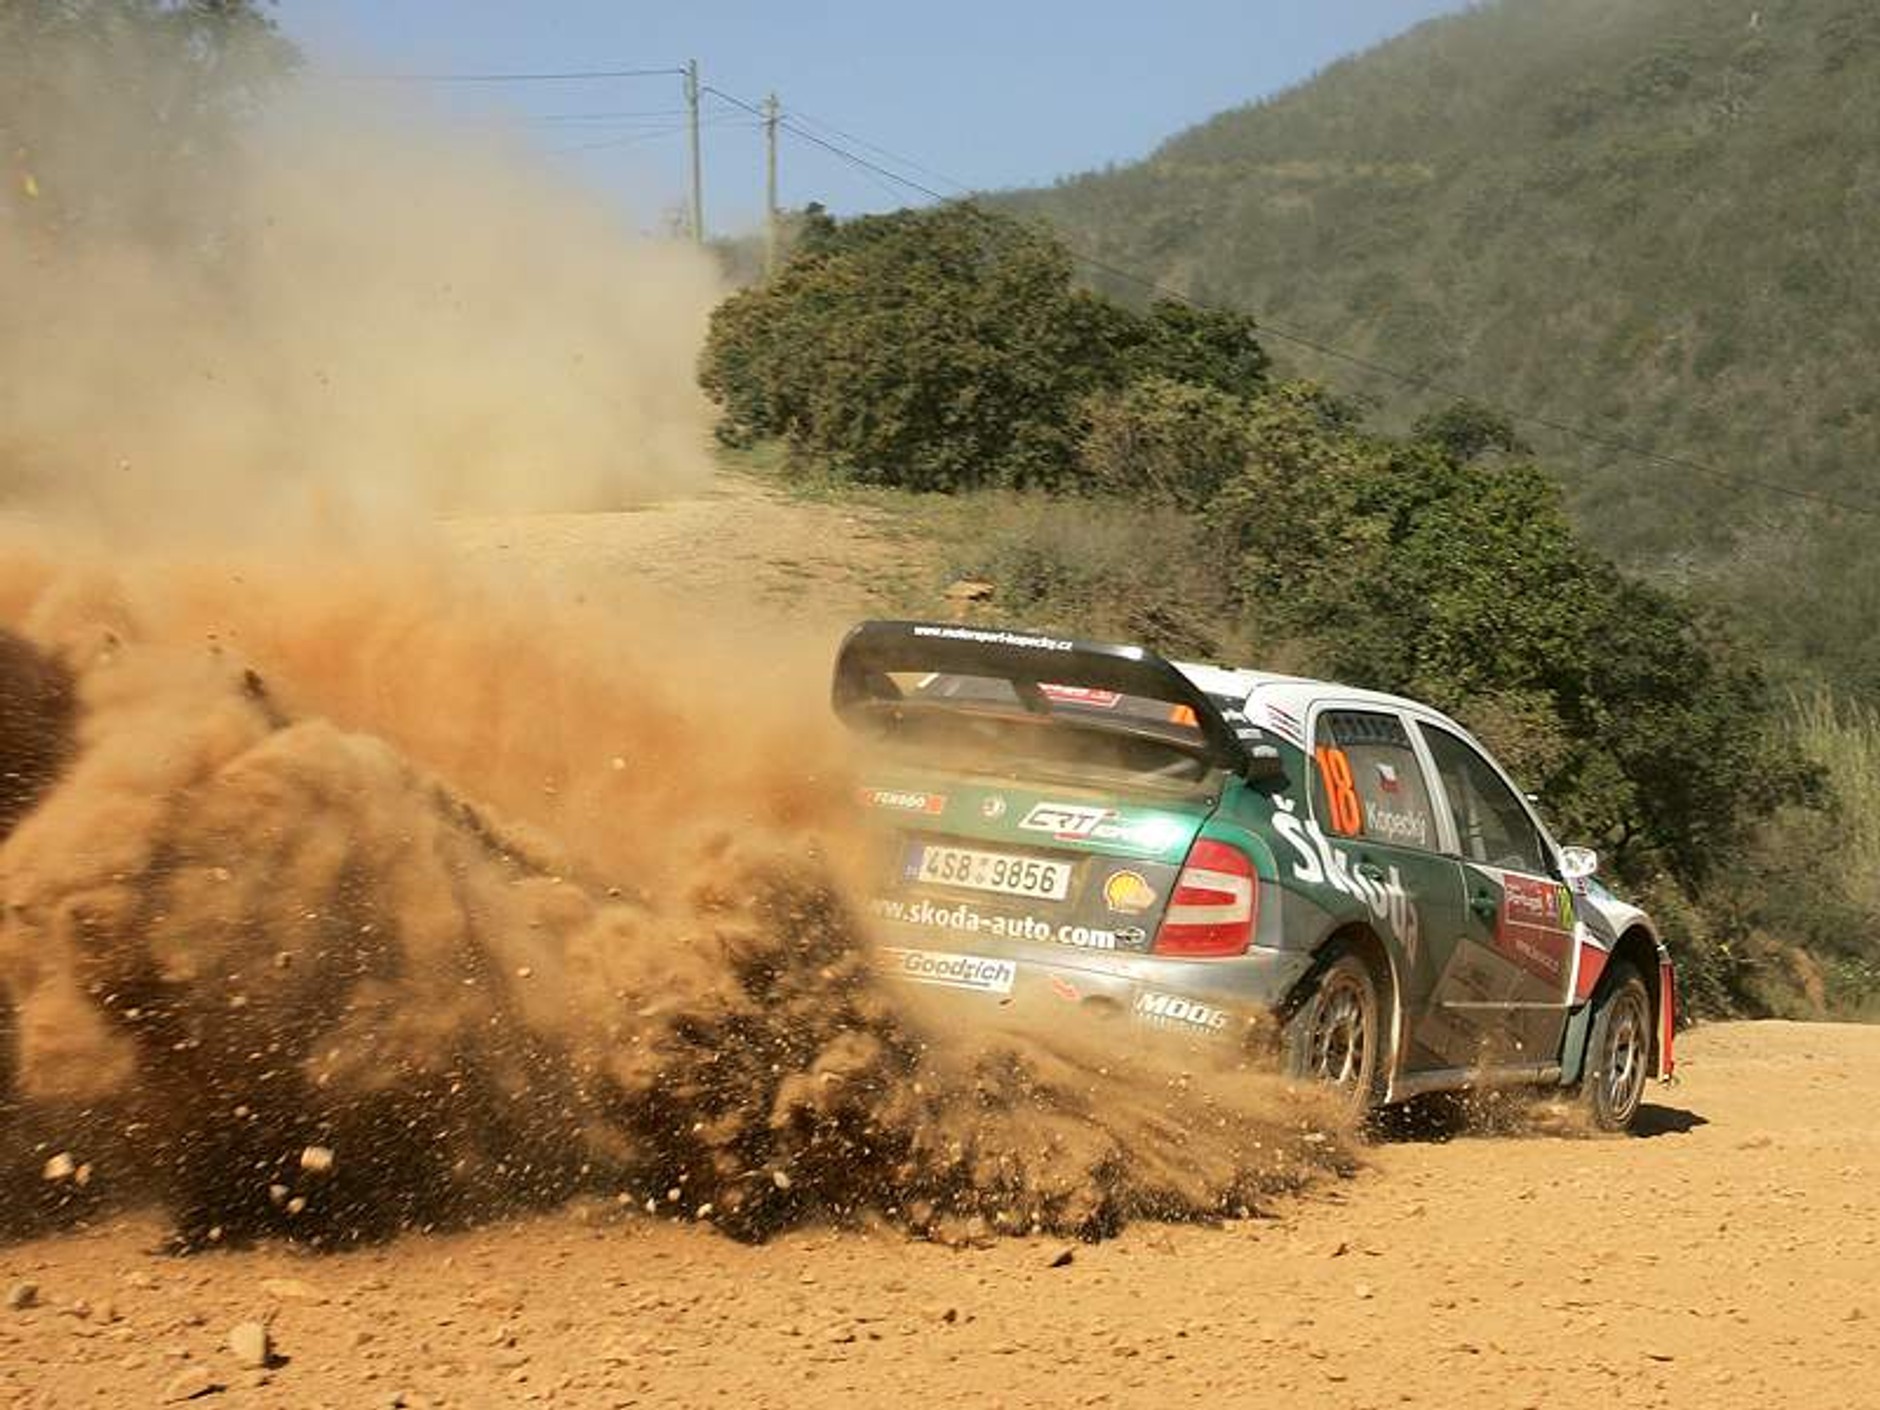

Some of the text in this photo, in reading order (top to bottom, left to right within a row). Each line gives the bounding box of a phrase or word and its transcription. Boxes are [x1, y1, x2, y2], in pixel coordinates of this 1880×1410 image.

[1315, 745, 1361, 837] 18
[925, 850, 972, 882] 4S8
[991, 859, 1056, 893] 9856
[868, 898, 1116, 949] ww.skoda-auto.com
